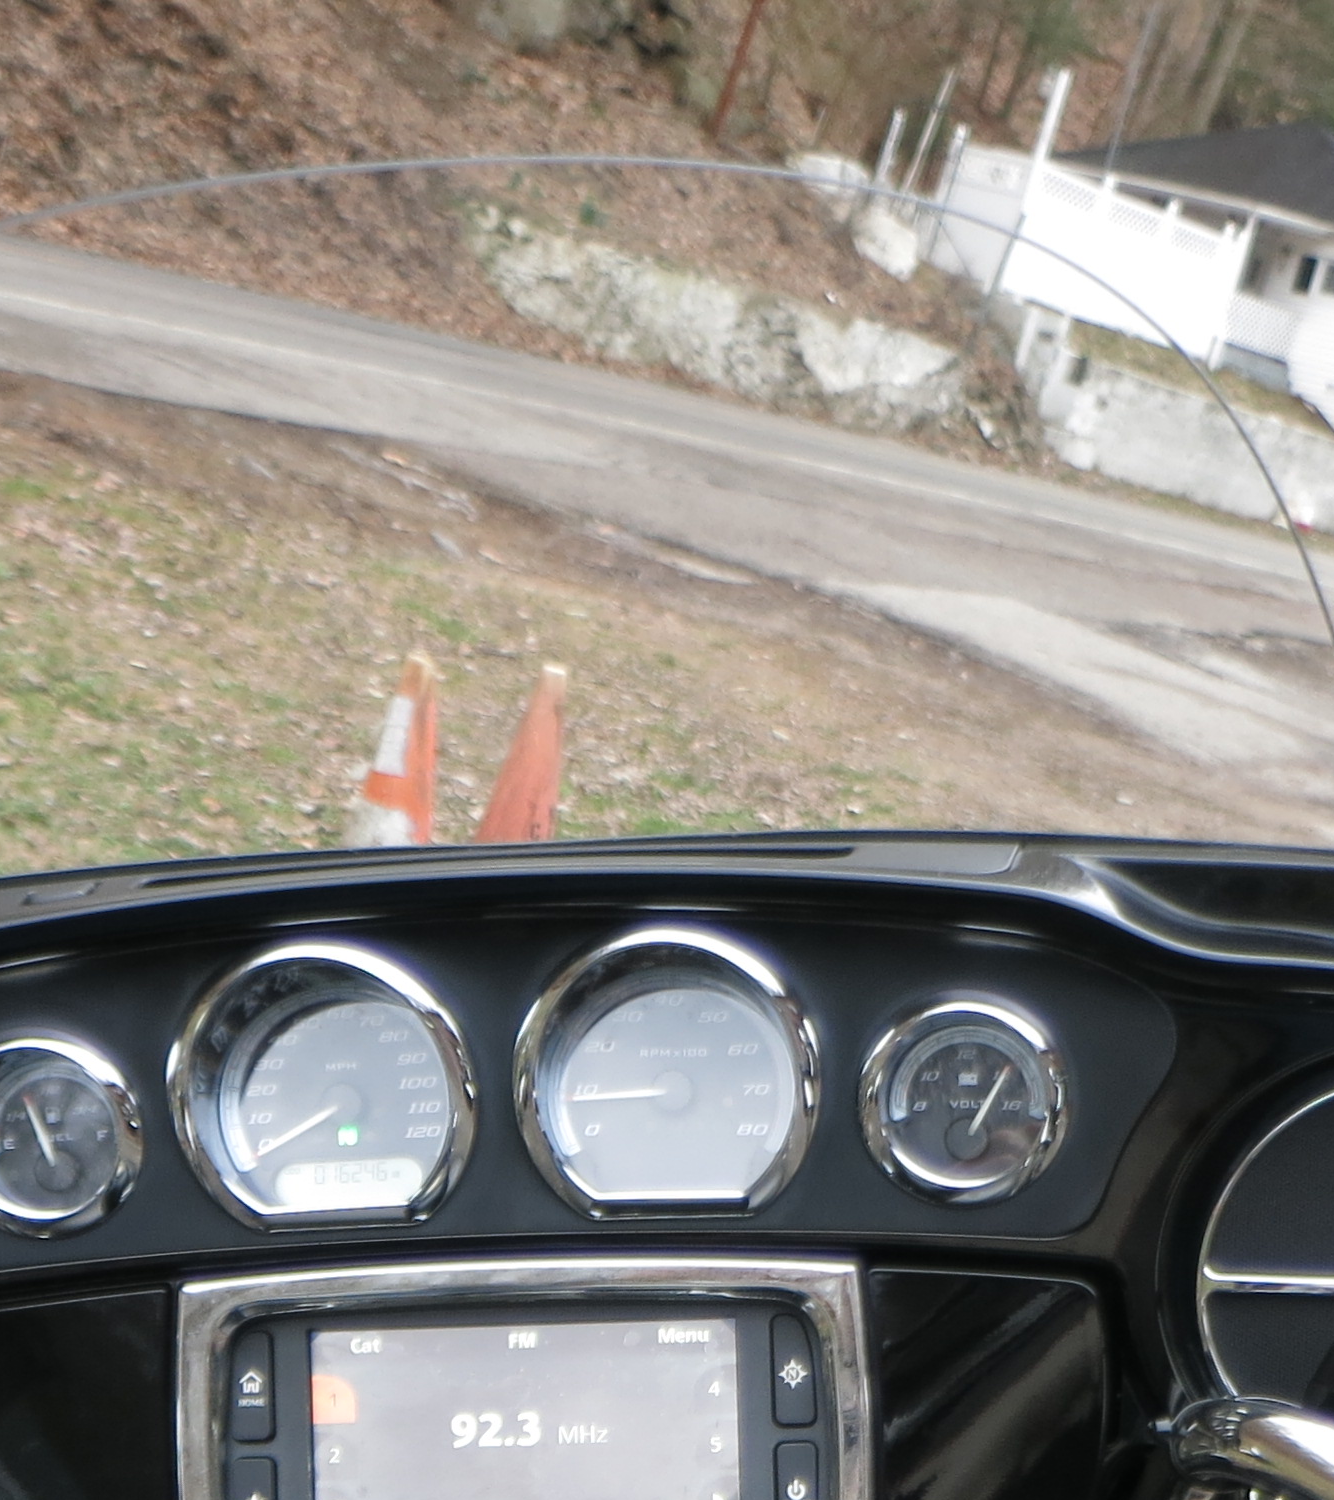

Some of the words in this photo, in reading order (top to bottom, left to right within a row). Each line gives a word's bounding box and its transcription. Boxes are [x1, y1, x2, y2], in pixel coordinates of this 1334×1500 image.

[612, 1011, 644, 1023] 30
[697, 1011, 728, 1024] 50
[378, 1031, 408, 1044] 80
[584, 1041, 615, 1053] 20
[727, 1043, 759, 1057] 60
[254, 1059, 285, 1071] 30
[397, 1053, 427, 1066] 90
[325, 1062, 358, 1073] MPH
[920, 1071, 940, 1082] 10
[398, 1077, 438, 1090] 100
[246, 1084, 277, 1097] 20
[574, 1084, 599, 1097] 10
[742, 1084, 770, 1097] 70
[407, 1101, 441, 1114] 110
[912, 1101, 927, 1112] 8
[248, 1112, 273, 1125] 10
[96, 1130, 109, 1142] F
[338, 1127, 358, 1146] N
[404, 1125, 442, 1138] 120
[584, 1123, 601, 1137] 0
[736, 1123, 770, 1137] 80
[3, 1139, 16, 1150] E
[507, 1333, 537, 1350] FM
[657, 1327, 710, 1345] Menu
[350, 1337, 382, 1355] Cat
[707, 1380, 721, 1398] 4
[450, 1412, 542, 1449] 92.3
[557, 1425, 609, 1446] MHz
[709, 1436, 723, 1454] 5
[328, 1448, 342, 1465] 2
